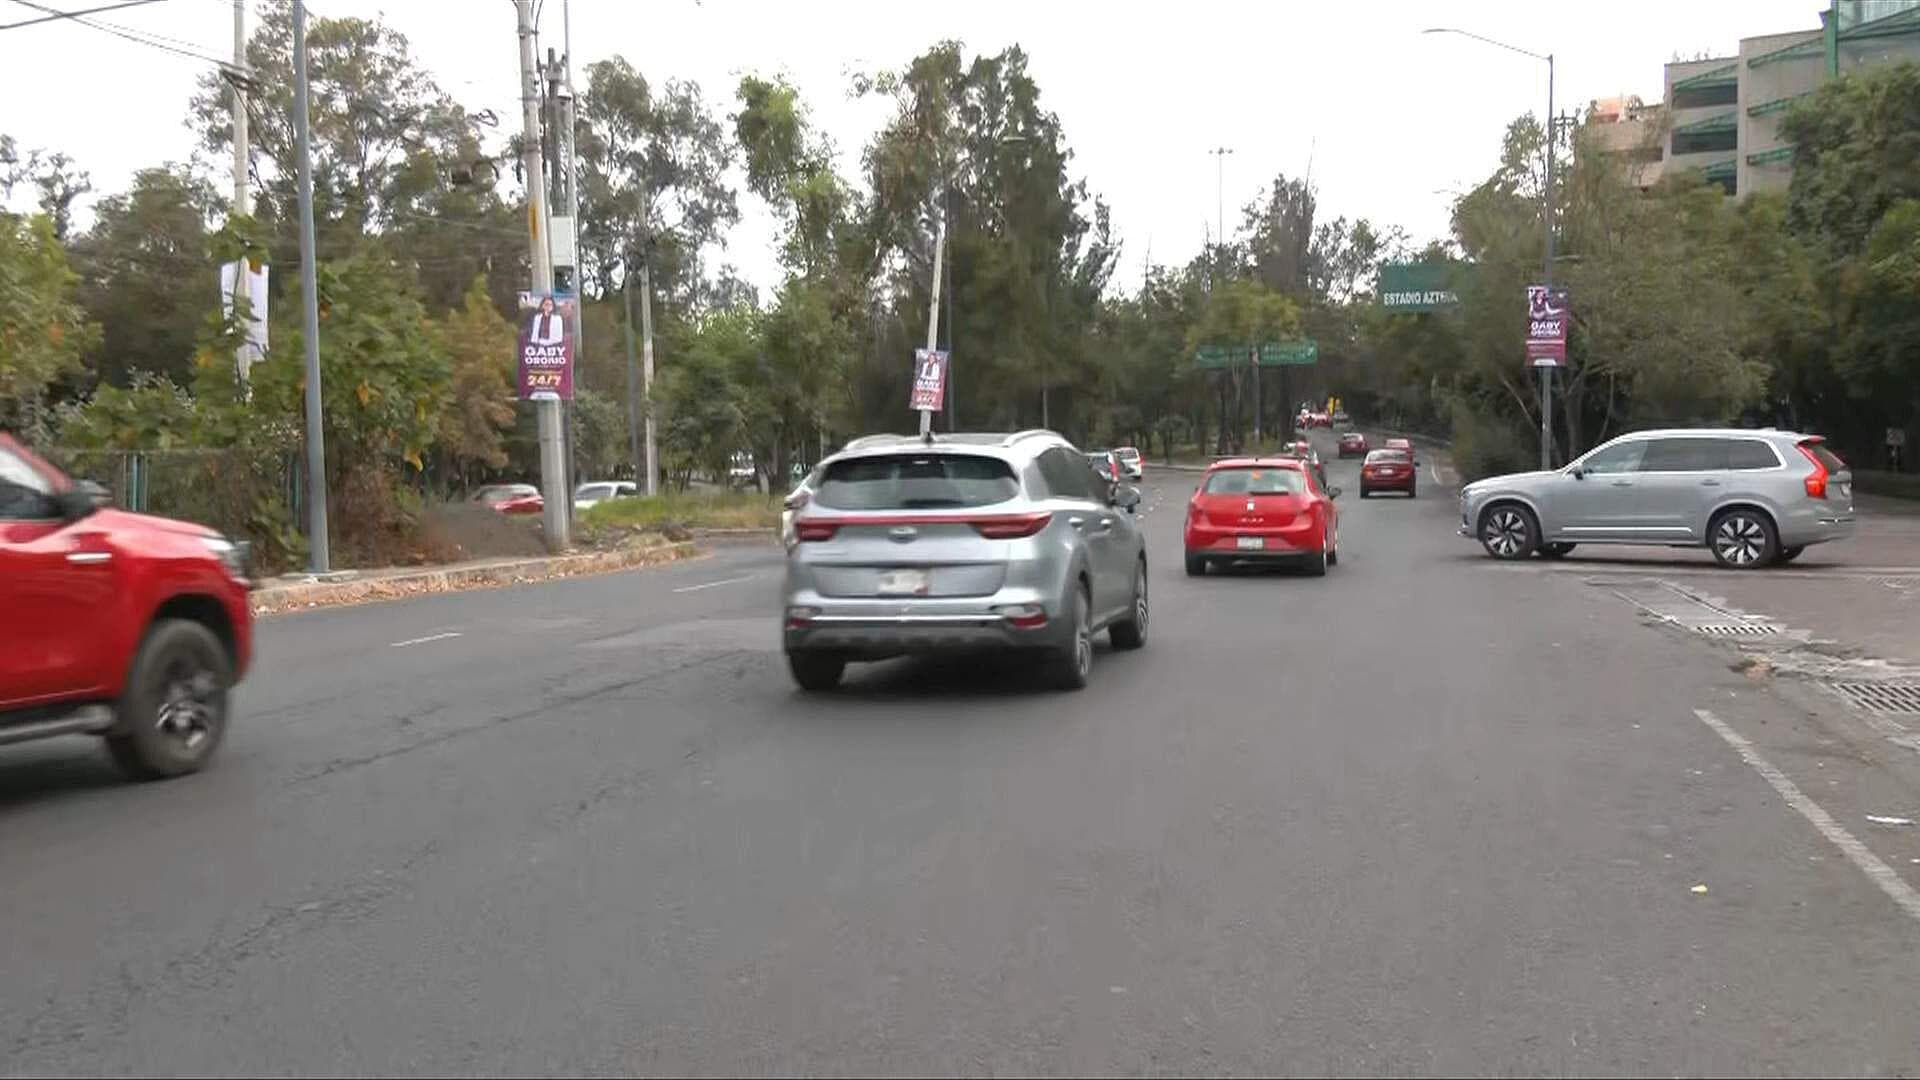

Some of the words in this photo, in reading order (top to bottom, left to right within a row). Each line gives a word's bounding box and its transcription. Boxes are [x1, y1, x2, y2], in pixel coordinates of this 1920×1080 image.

[1383, 291, 1421, 305] ESTADIO
[525, 346, 566, 356] GABY
[527, 375, 562, 386] 24/7
